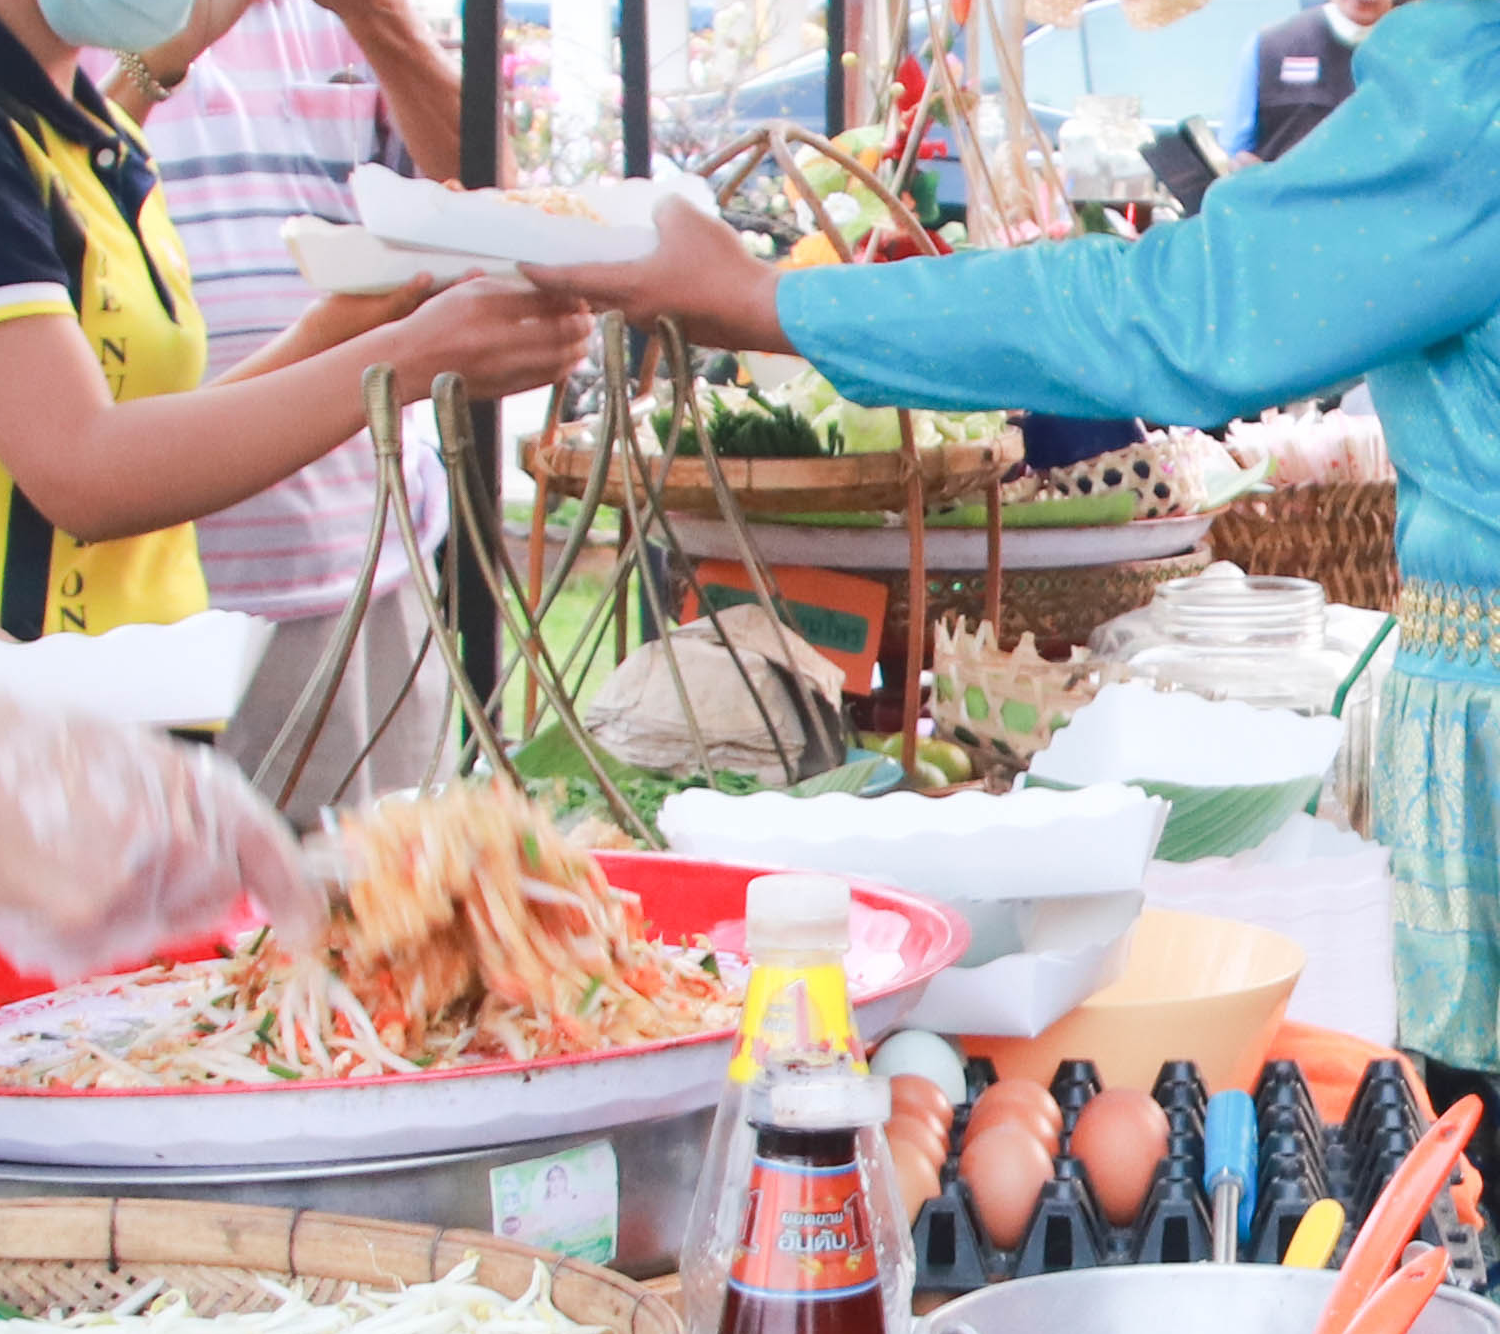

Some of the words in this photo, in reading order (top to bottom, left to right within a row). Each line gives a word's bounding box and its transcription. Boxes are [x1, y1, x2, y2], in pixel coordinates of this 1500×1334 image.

[60, 568, 87, 633] ON
[777, 1228, 847, 1252] อันดับ
[844, 1190, 871, 1255] 1
